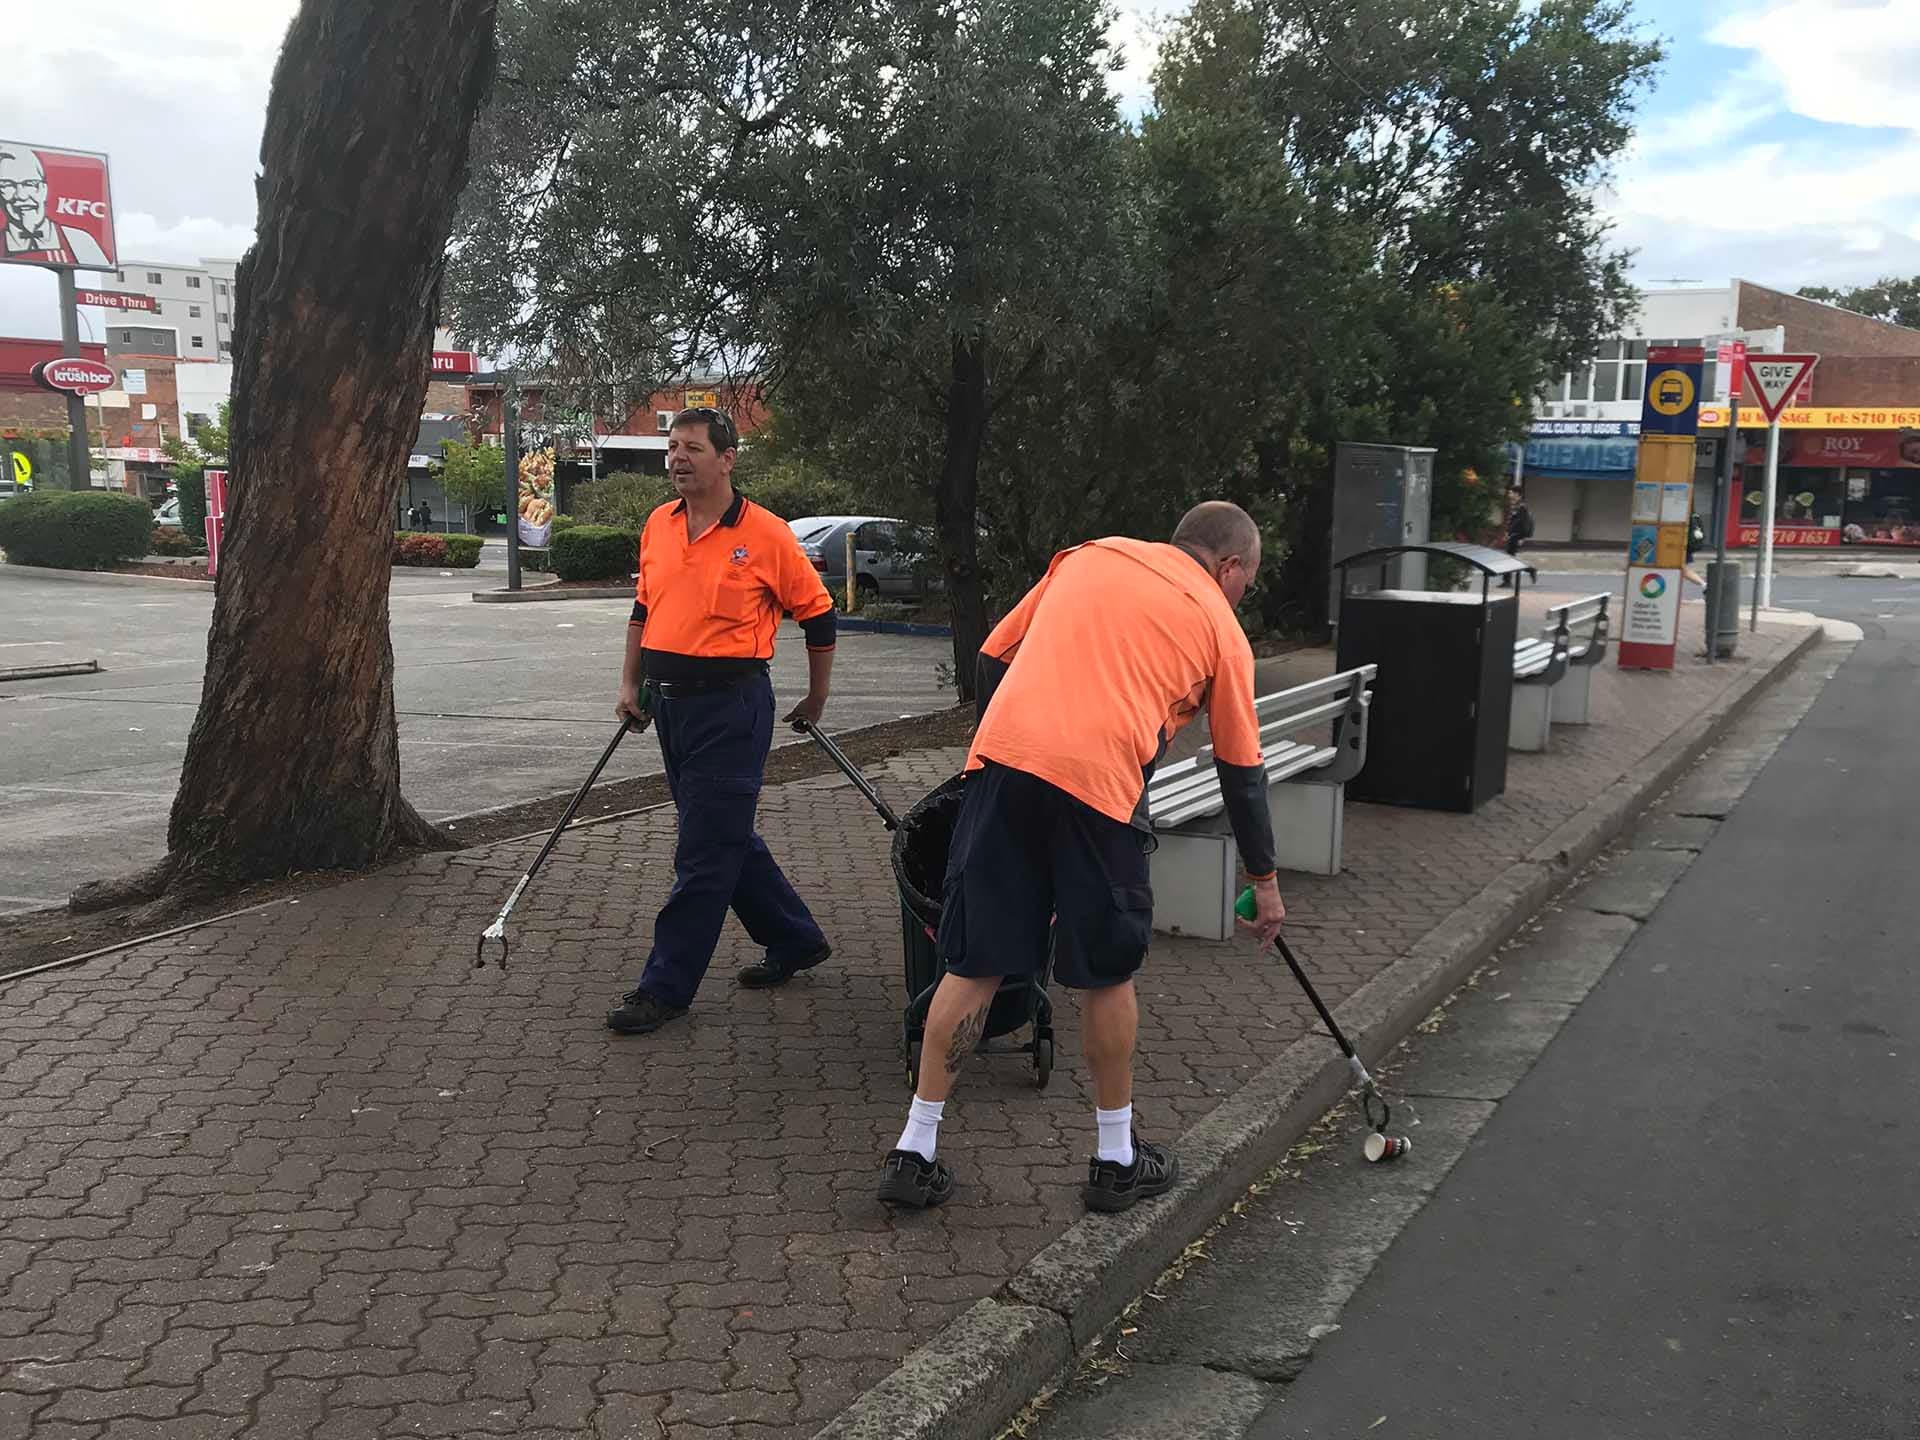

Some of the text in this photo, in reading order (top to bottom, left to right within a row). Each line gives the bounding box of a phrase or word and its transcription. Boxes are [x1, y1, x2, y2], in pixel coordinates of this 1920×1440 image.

[56, 196, 106, 218] KFC
[85, 292, 148, 309] Drive Thru
[1760, 366, 1793, 378] GIVE
[1764, 381, 1786, 389] WAY
[1851, 412, 1887, 424] 8710
[1824, 436, 1863, 450] ROY
